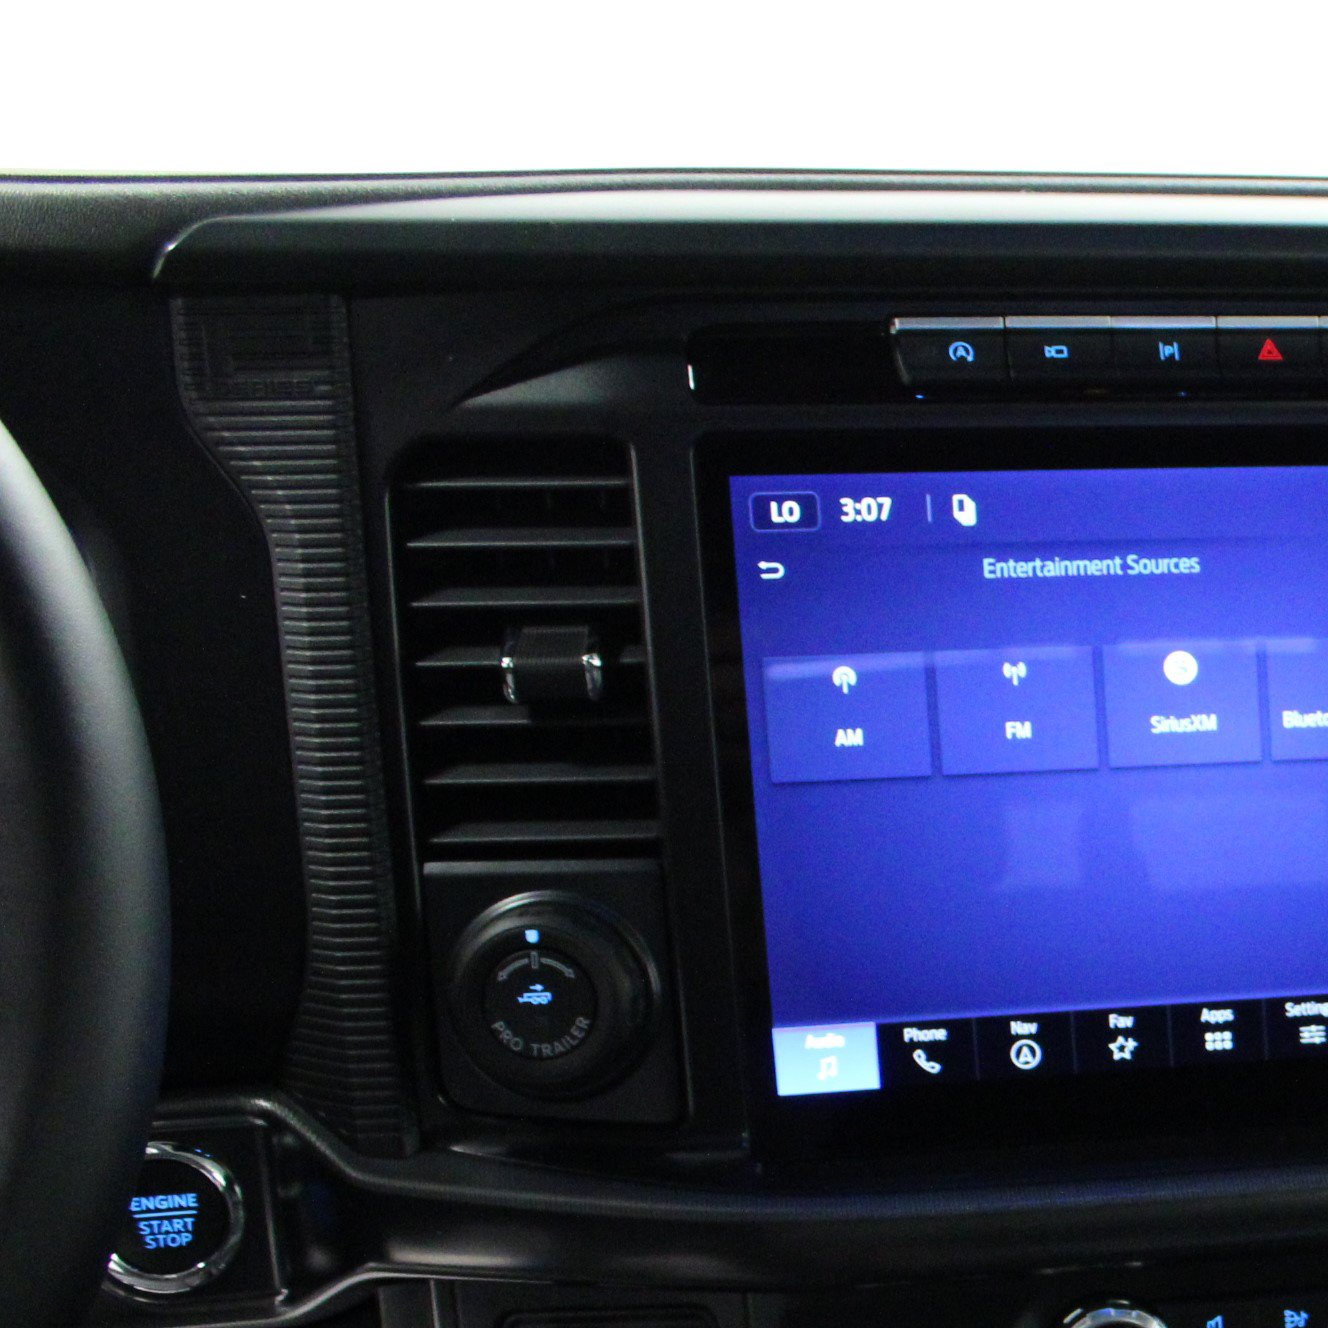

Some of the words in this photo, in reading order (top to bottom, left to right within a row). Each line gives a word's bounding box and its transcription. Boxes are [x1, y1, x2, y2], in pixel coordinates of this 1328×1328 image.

[769, 500, 801, 525] LO
[839, 496, 893, 523] 3:07
[982, 556, 1123, 579] Entertainment
[1126, 553, 1201, 576] Sources
[1005, 720, 1032, 741] FM
[1150, 713, 1218, 734] SiriusXM
[834, 727, 864, 748] AM
[1108, 1013, 1134, 1029] Fav
[1200, 1006, 1233, 1024] Apps
[490, 1020, 523, 1051] PRO
[530, 1016, 592, 1058] TRAILER
[903, 1025, 947, 1043] Phone
[1010, 1020, 1038, 1036] Nav
[130, 1193, 199, 1212] ENGINE
[137, 1217, 196, 1236] START
[144, 1233, 193, 1250] STOP
